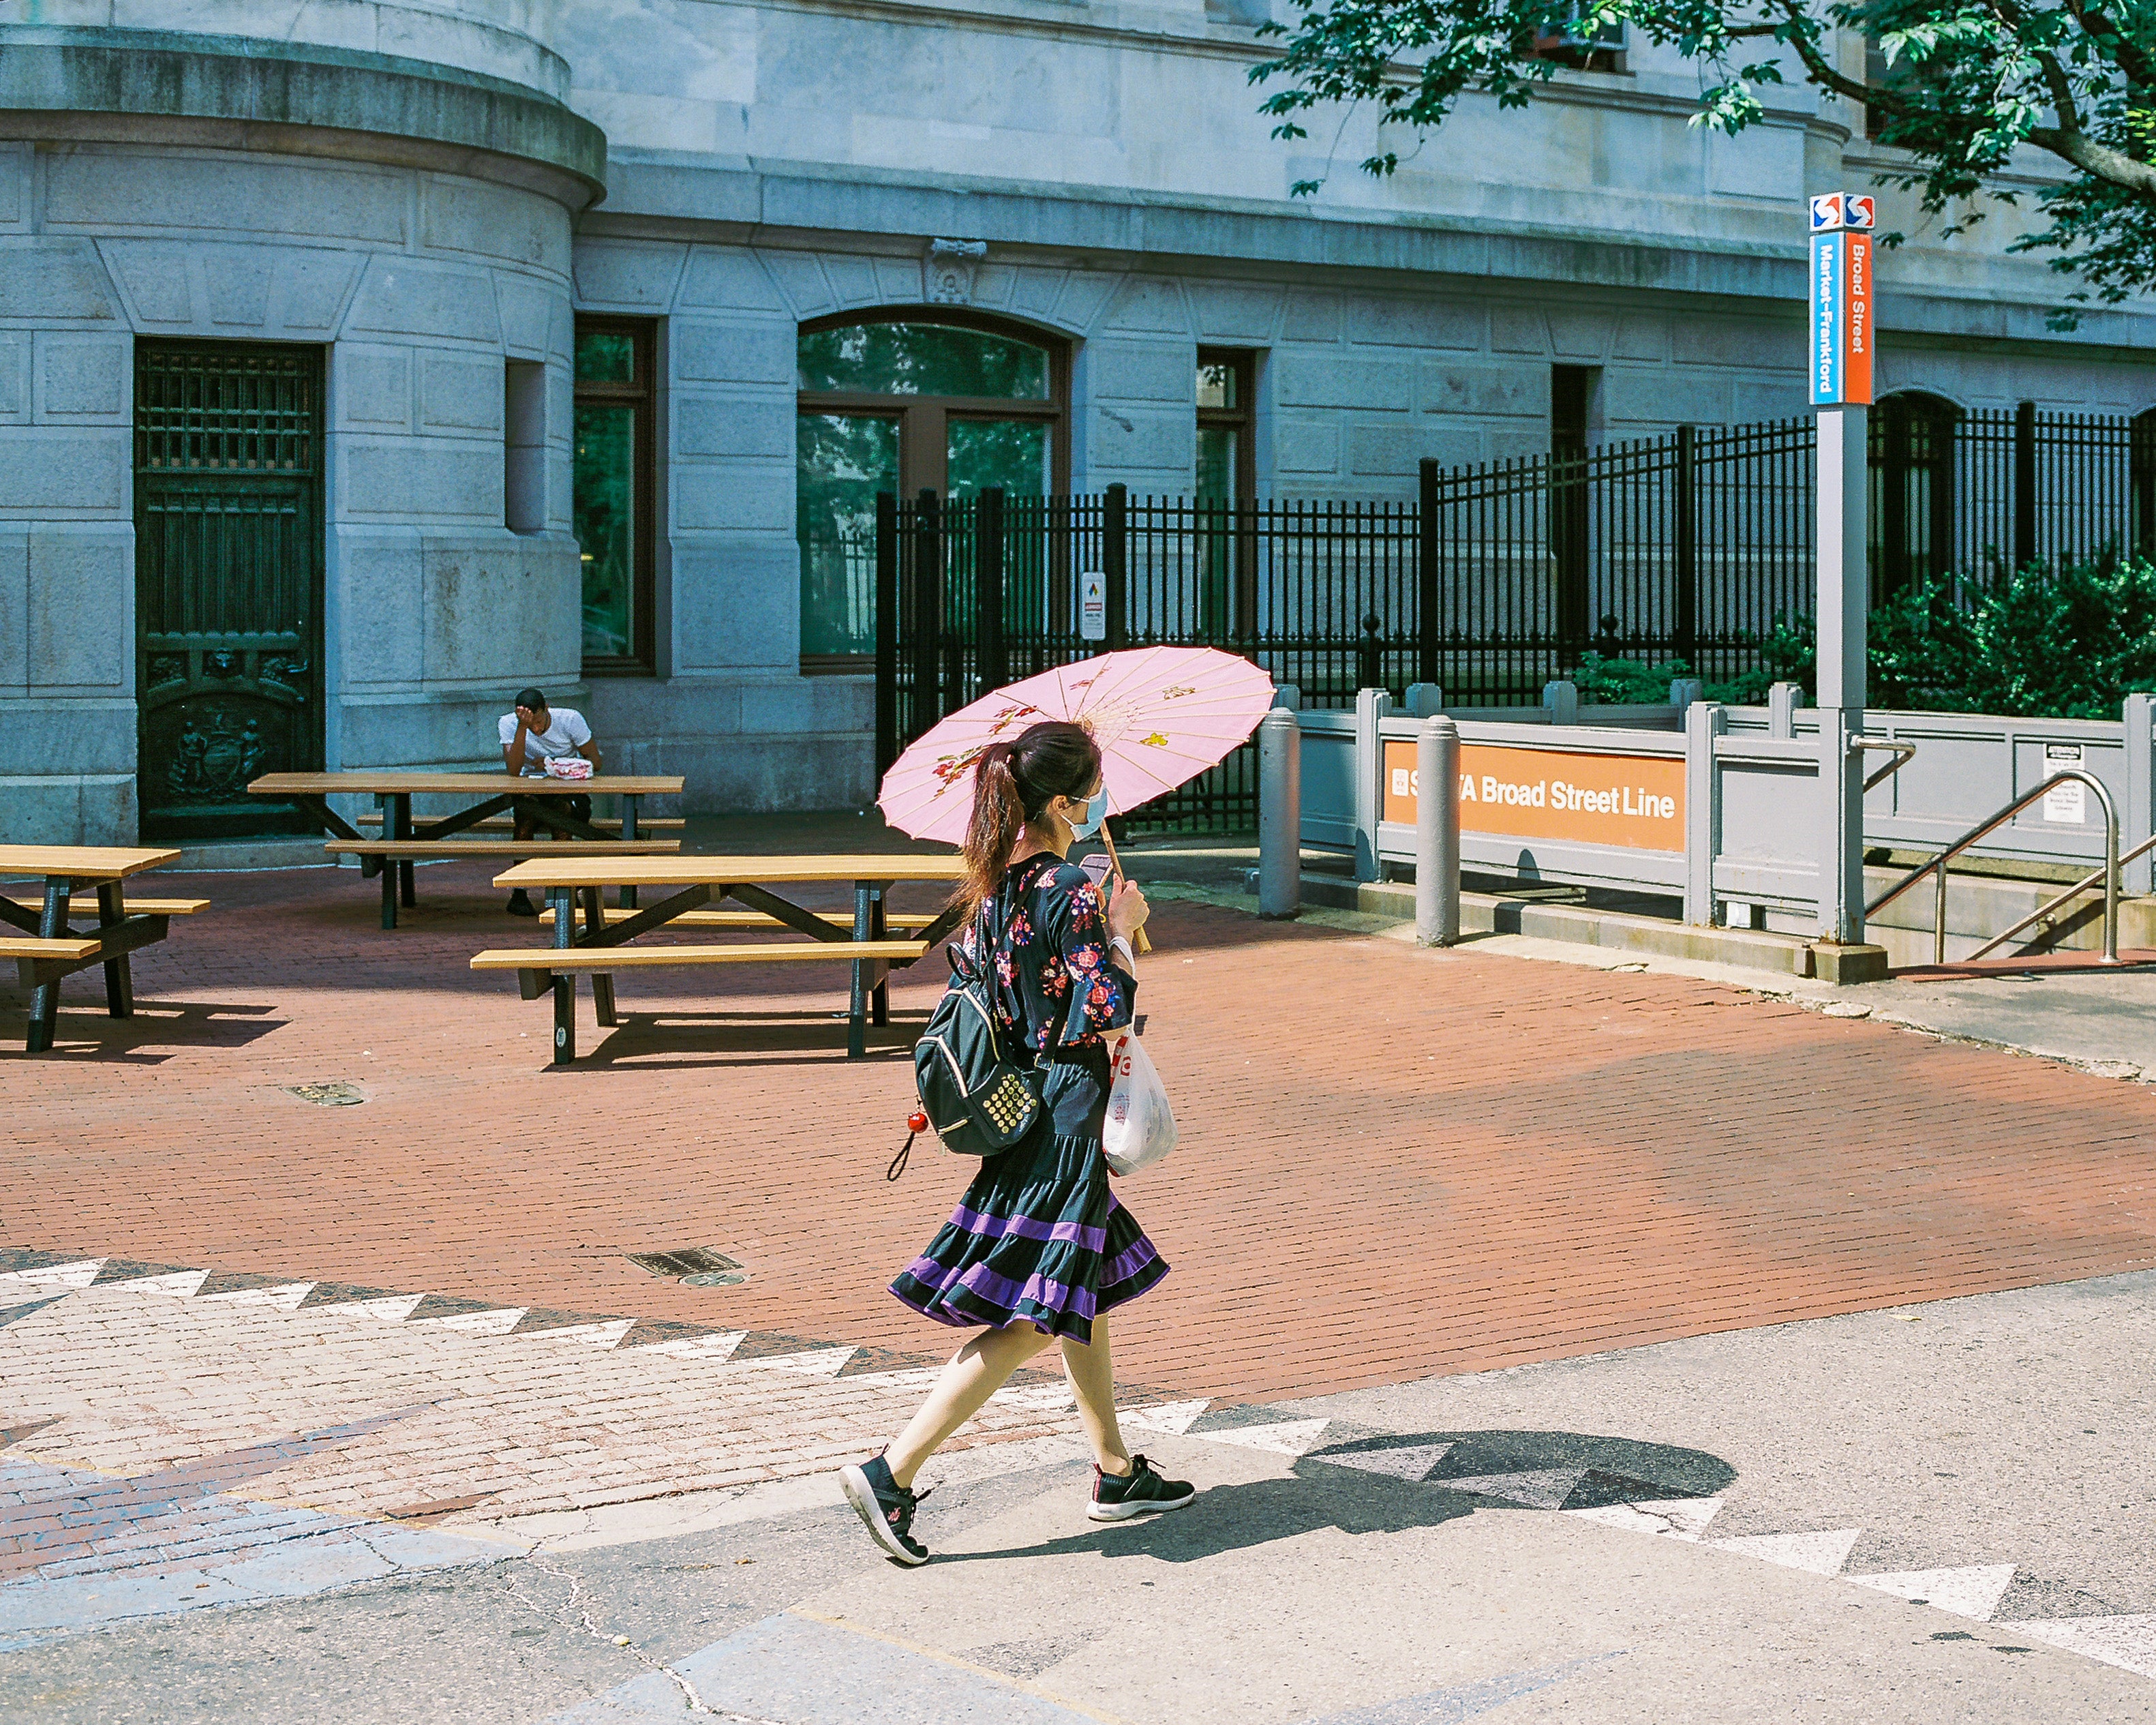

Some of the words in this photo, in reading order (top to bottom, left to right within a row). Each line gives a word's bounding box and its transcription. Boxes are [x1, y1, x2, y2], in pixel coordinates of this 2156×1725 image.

[1853, 244, 1866, 296] Broad
[1819, 244, 1833, 393] Market-Frankford
[1852, 301, 1866, 354] Street
[1482, 775, 1546, 808] Broad
[1550, 780, 1620, 814] Street
[1622, 786, 1675, 820] Line
